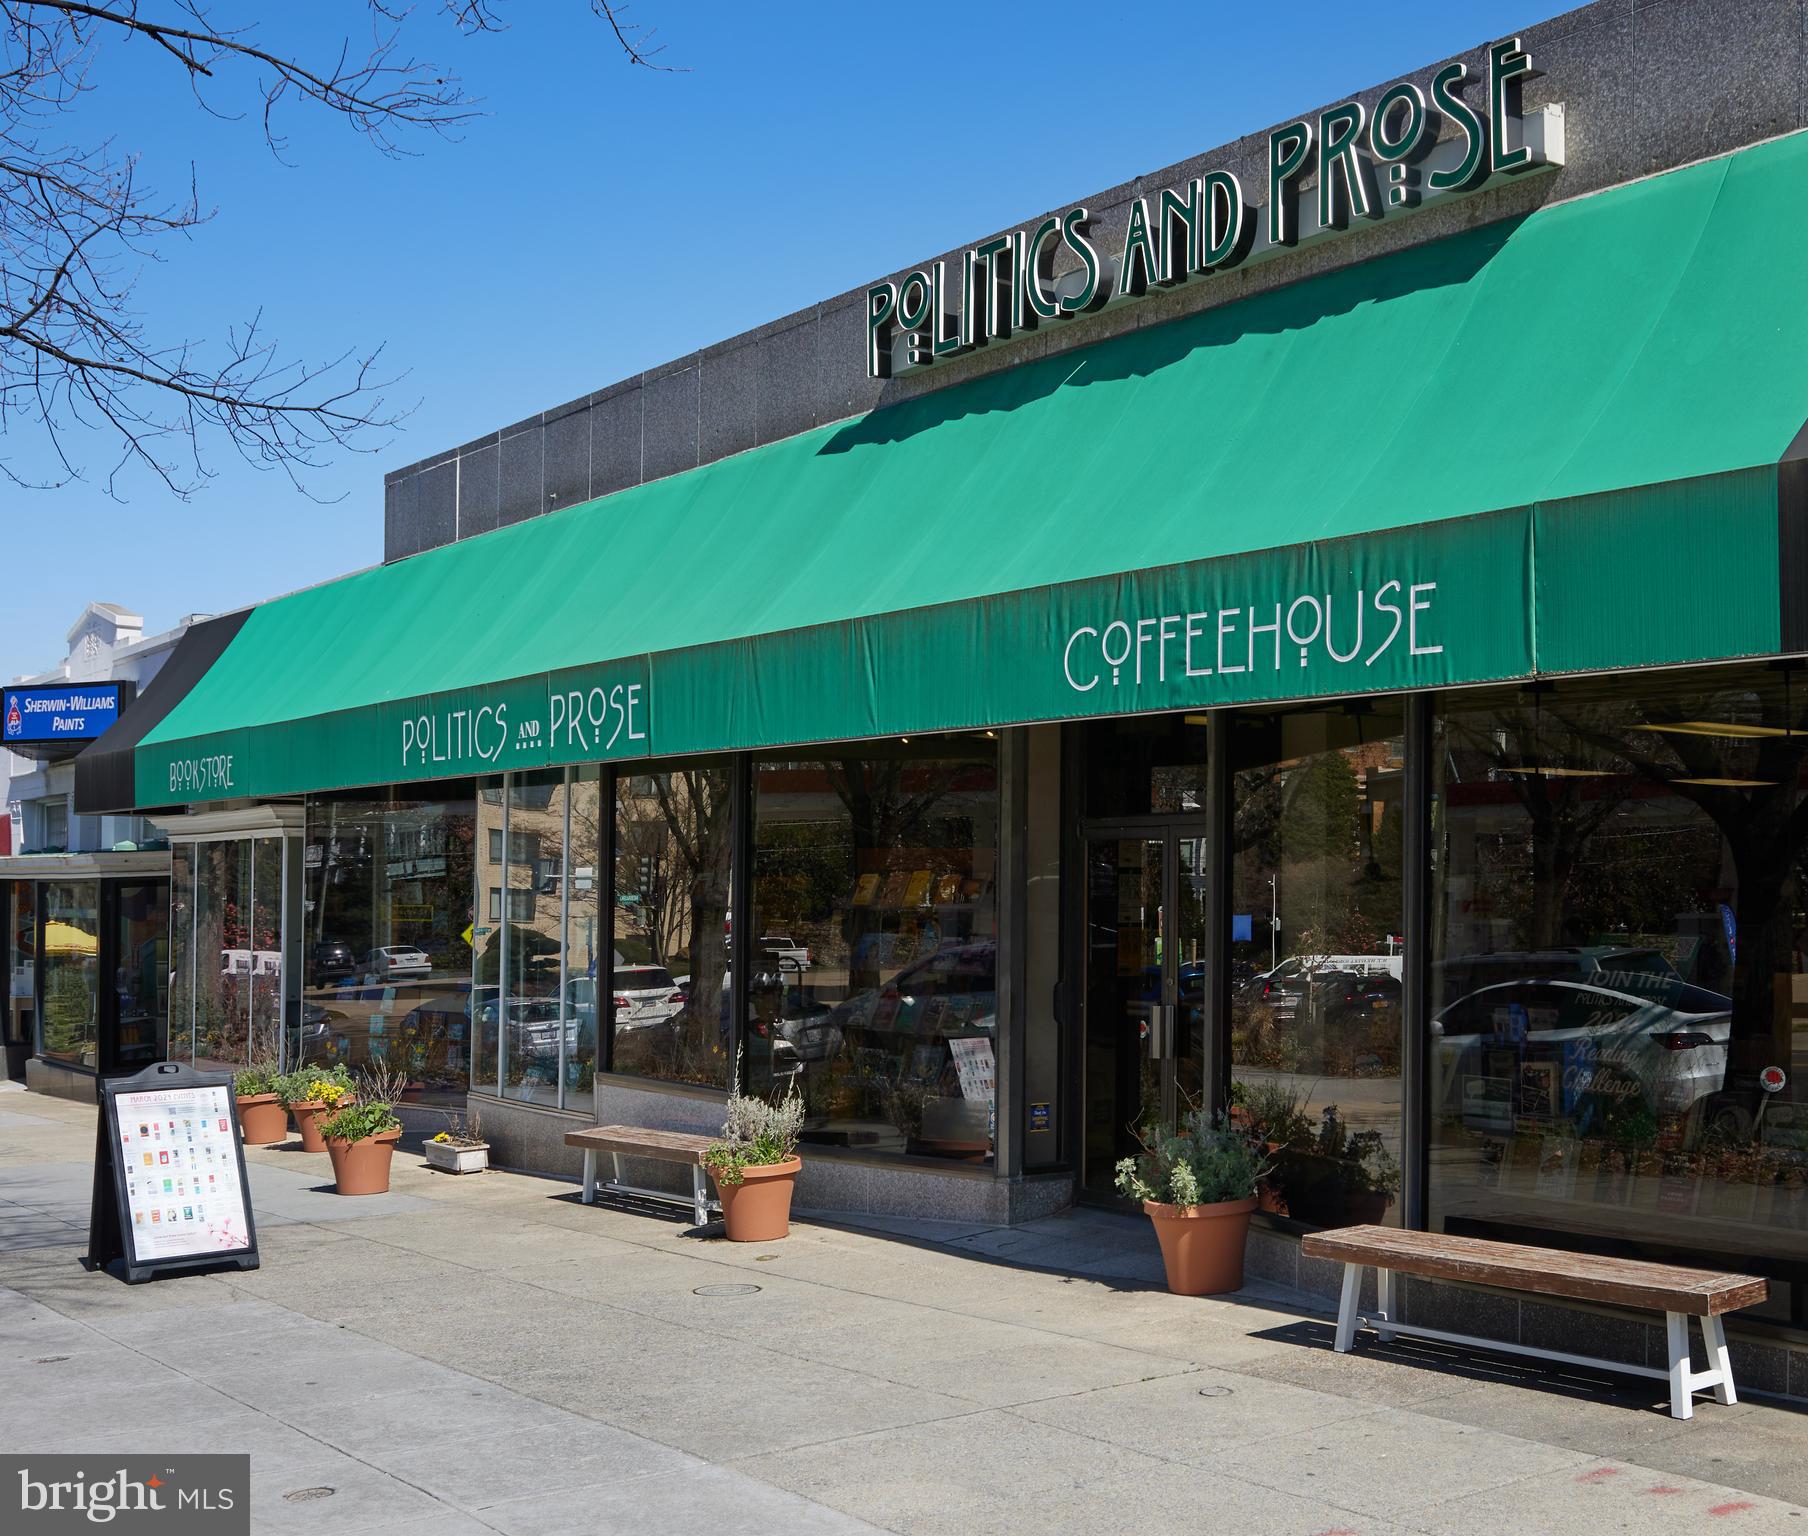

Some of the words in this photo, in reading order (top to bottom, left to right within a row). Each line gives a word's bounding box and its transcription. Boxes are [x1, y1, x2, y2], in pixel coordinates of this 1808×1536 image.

[866, 207, 1101, 379] POLITICS
[1118, 169, 1244, 296] AND
[1268, 37, 1534, 245] PROSE
[1064, 579, 1444, 692] COFFEEHOUSE
[24, 695, 116, 713] SHERWIN-WILLIAMS
[52, 716, 86, 732] PAINTS
[403, 703, 508, 767] POLITICS
[517, 720, 541, 742] AND
[550, 684, 646, 752] PROSE
[169, 755, 234, 792] BOOKSTORE
[1584, 969, 1634, 988] JOIN
[1636, 970, 1676, 989] THE
[1568, 1036, 1641, 1071] Reading
[1562, 1064, 1641, 1104] Challenge
